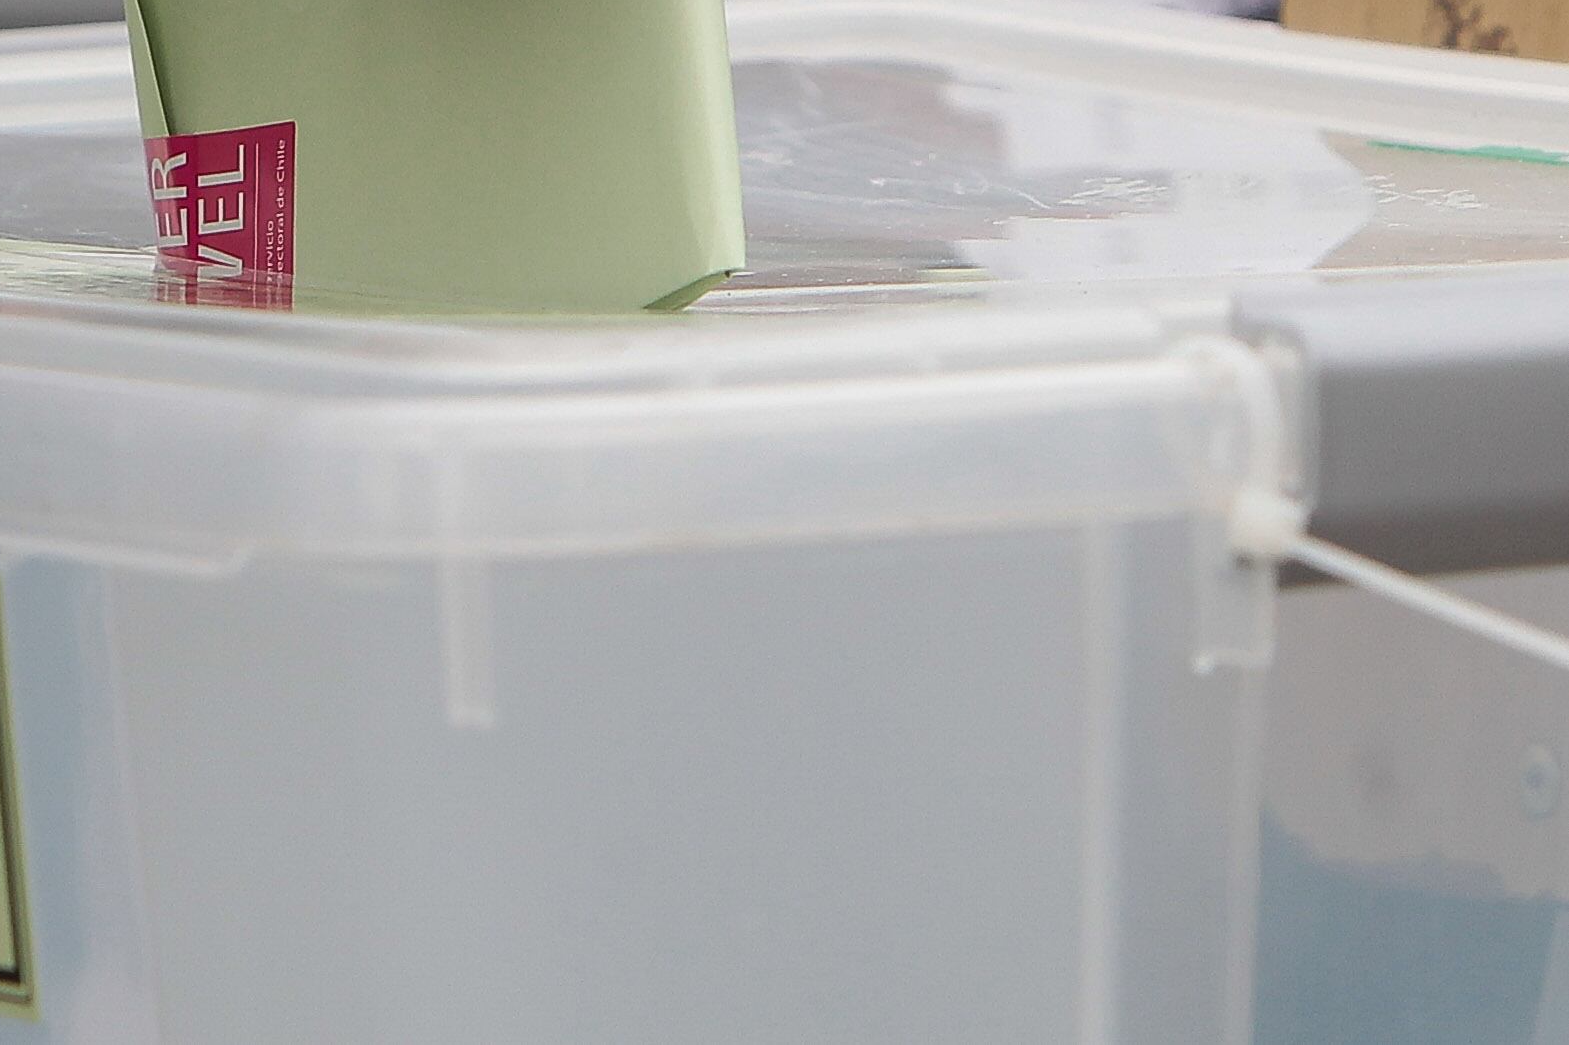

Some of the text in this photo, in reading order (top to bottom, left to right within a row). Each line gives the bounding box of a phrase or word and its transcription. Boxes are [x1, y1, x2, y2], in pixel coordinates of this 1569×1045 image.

[276, 139, 285, 184] Chile
[151, 152, 188, 248] ER
[276, 186, 285, 209] de
